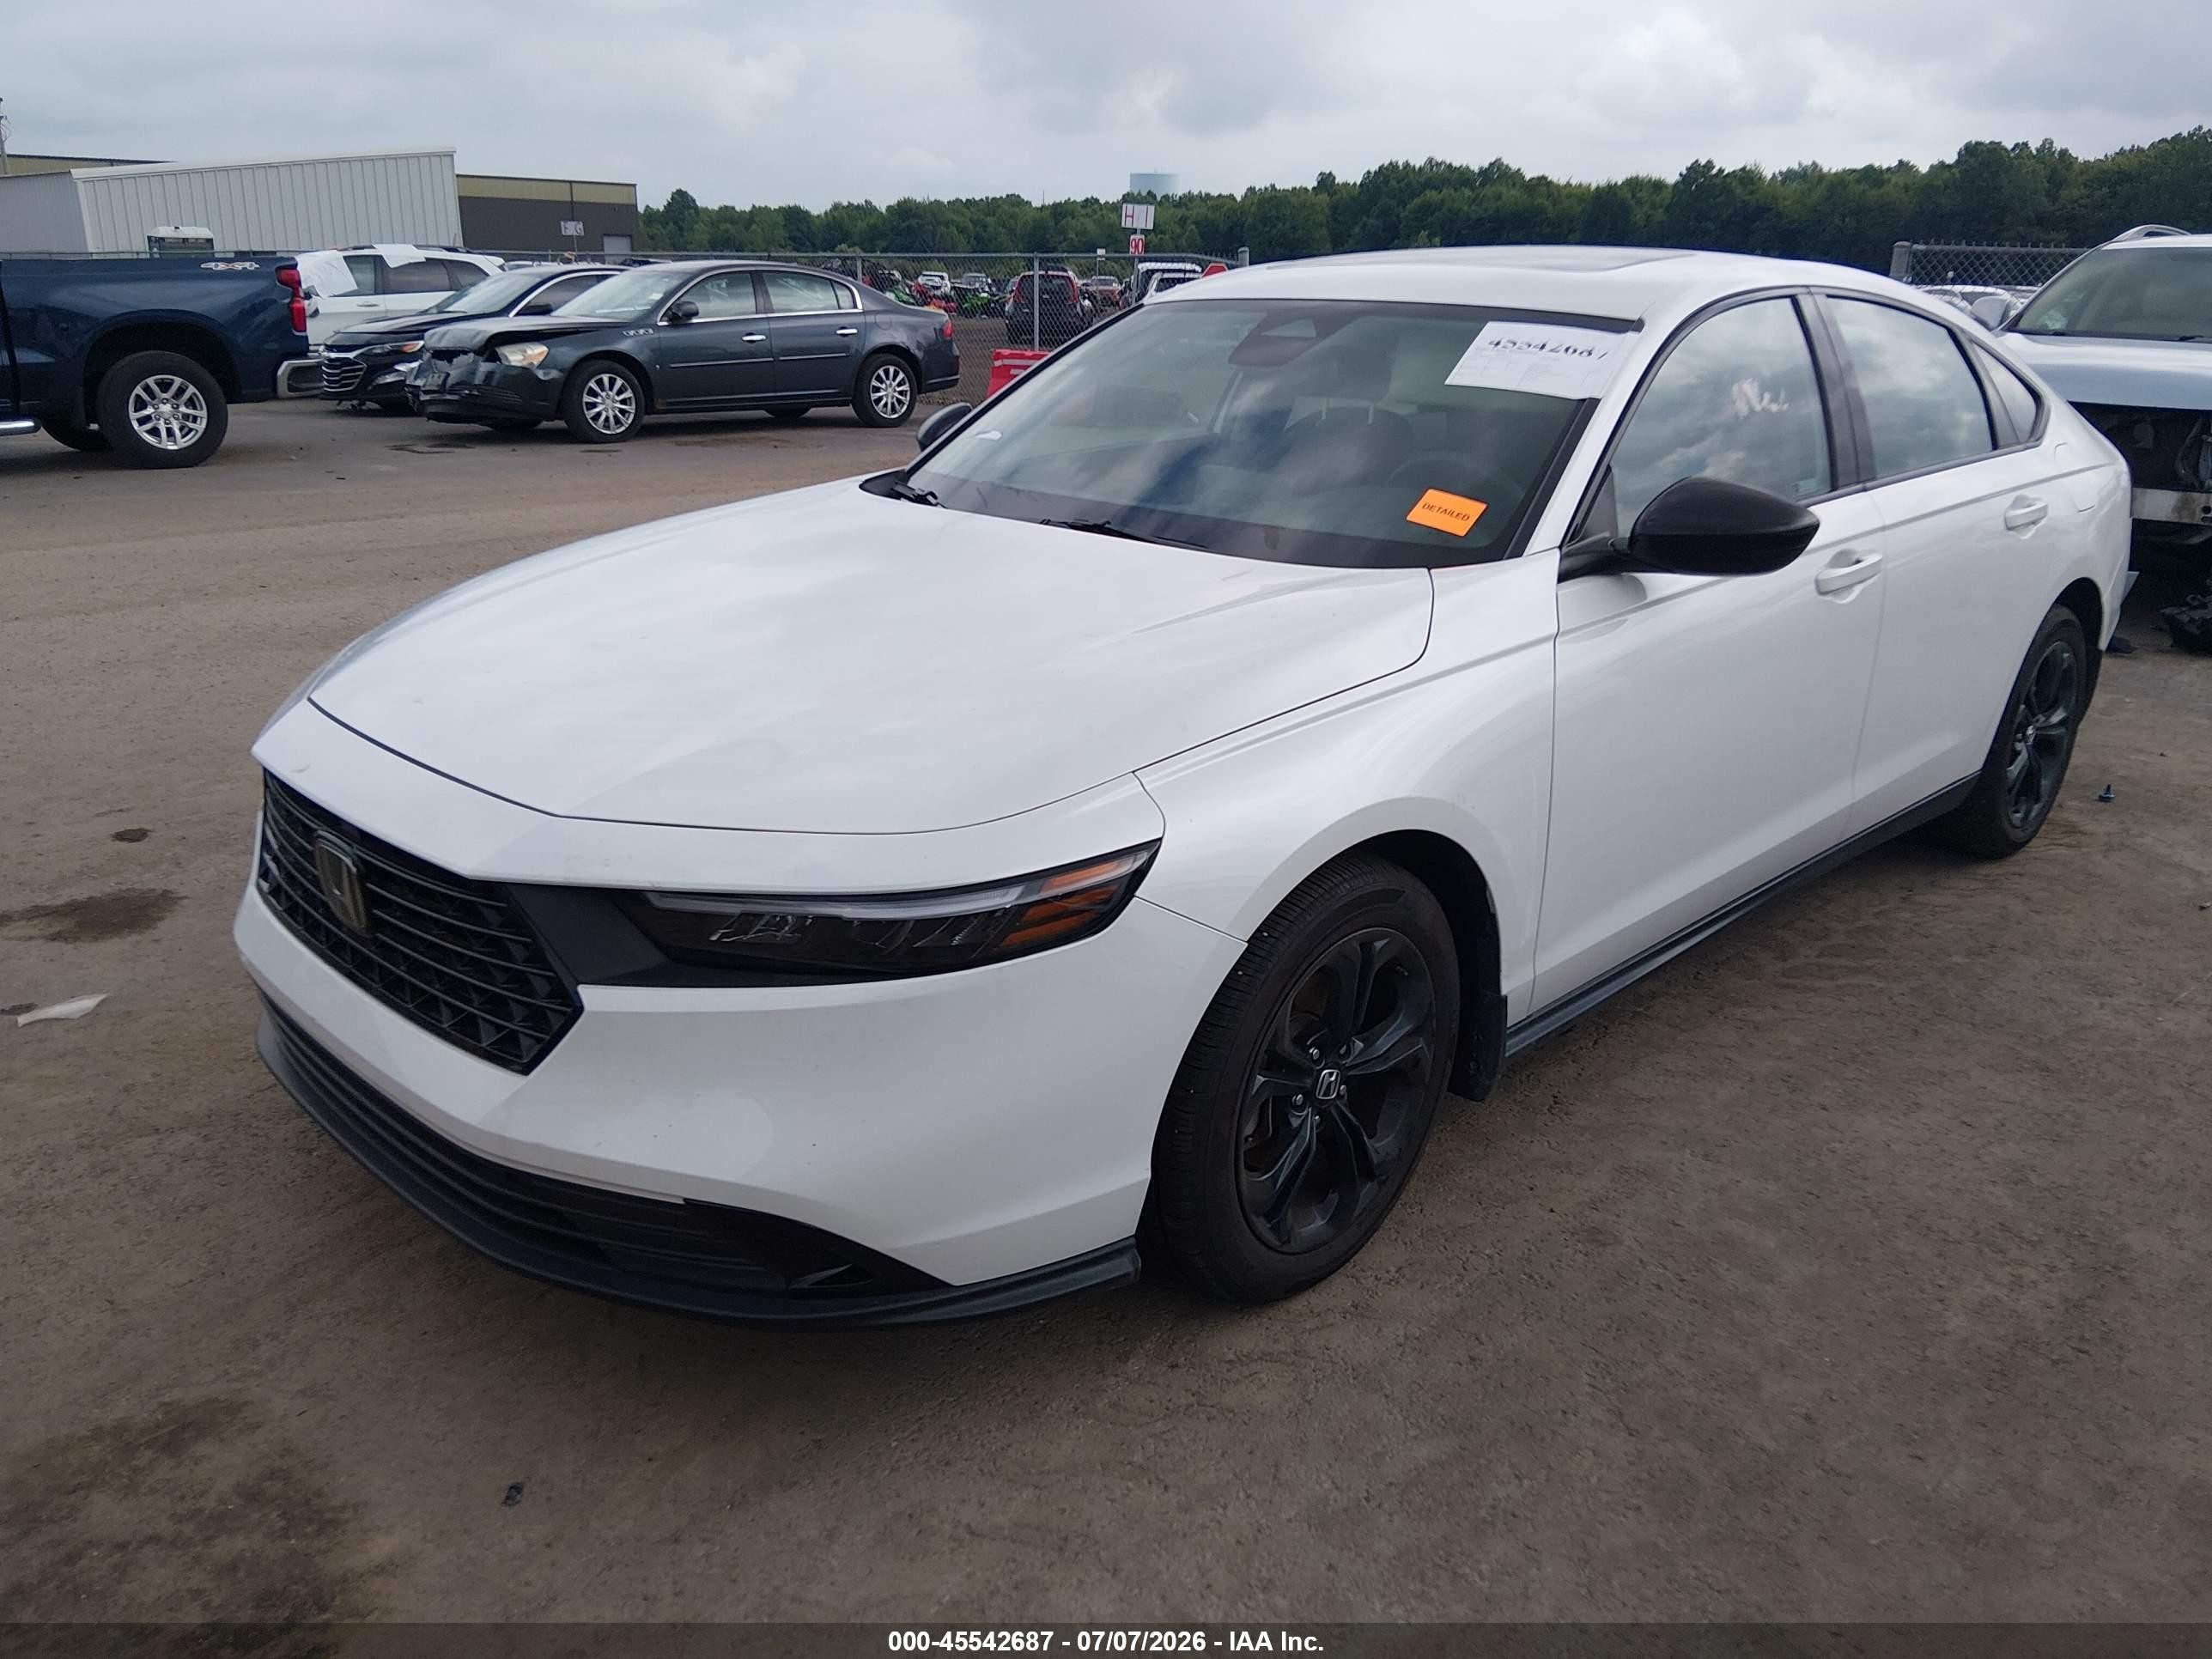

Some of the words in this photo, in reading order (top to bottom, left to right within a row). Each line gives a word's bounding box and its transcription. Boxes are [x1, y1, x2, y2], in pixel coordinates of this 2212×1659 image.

[1124, 205, 1134, 228] H
[1130, 238, 1144, 255] 90
[1422, 502, 1470, 521] DETAILED
